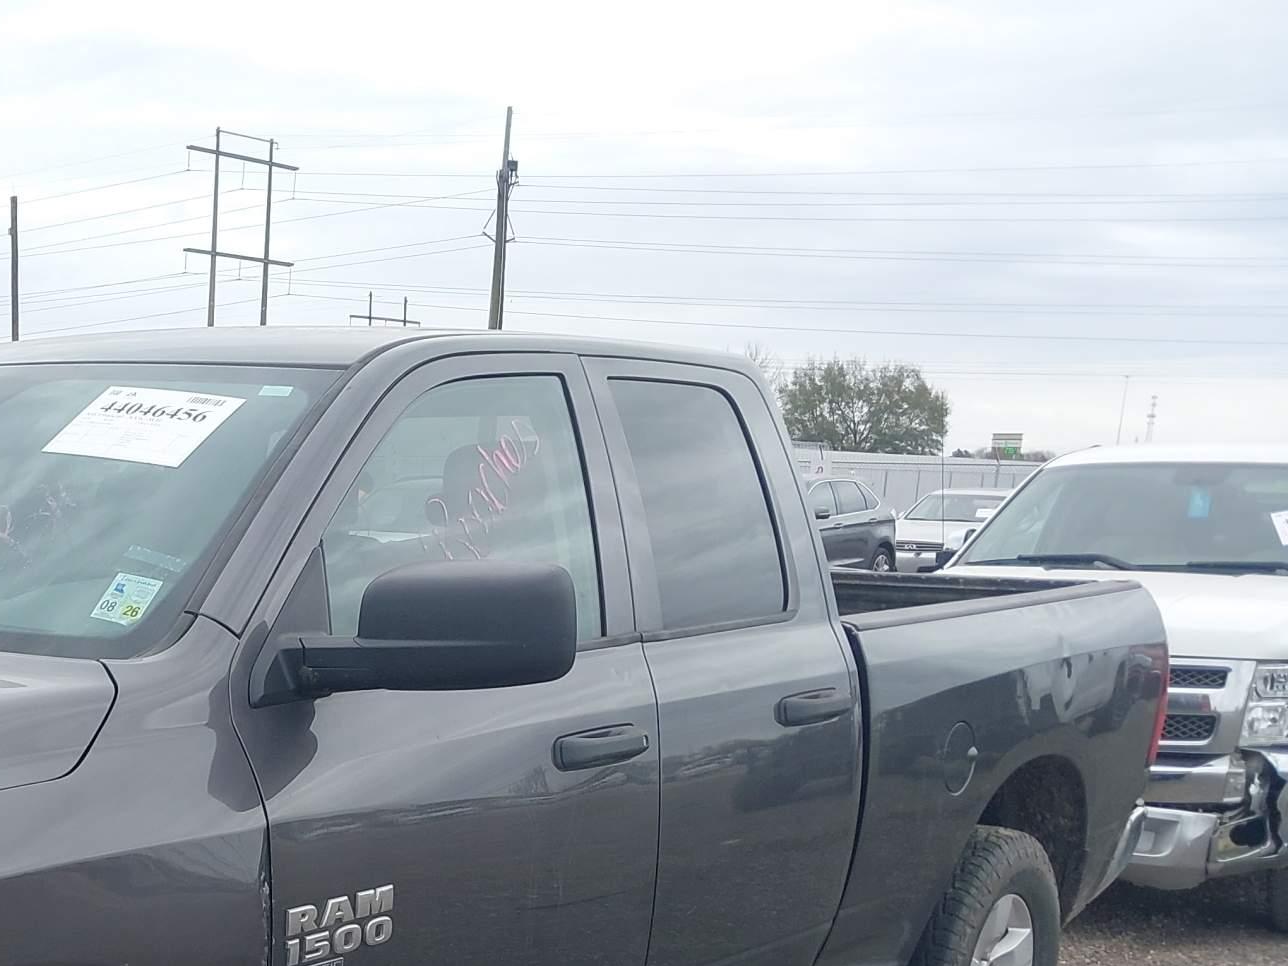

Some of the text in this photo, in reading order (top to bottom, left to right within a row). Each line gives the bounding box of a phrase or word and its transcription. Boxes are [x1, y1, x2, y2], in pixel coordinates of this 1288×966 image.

[100, 400, 215, 423] 44046456
[99, 599, 117, 612] 08
[122, 605, 141, 618] 26
[285, 884, 394, 936] RAM
[285, 915, 394, 966] 1500
